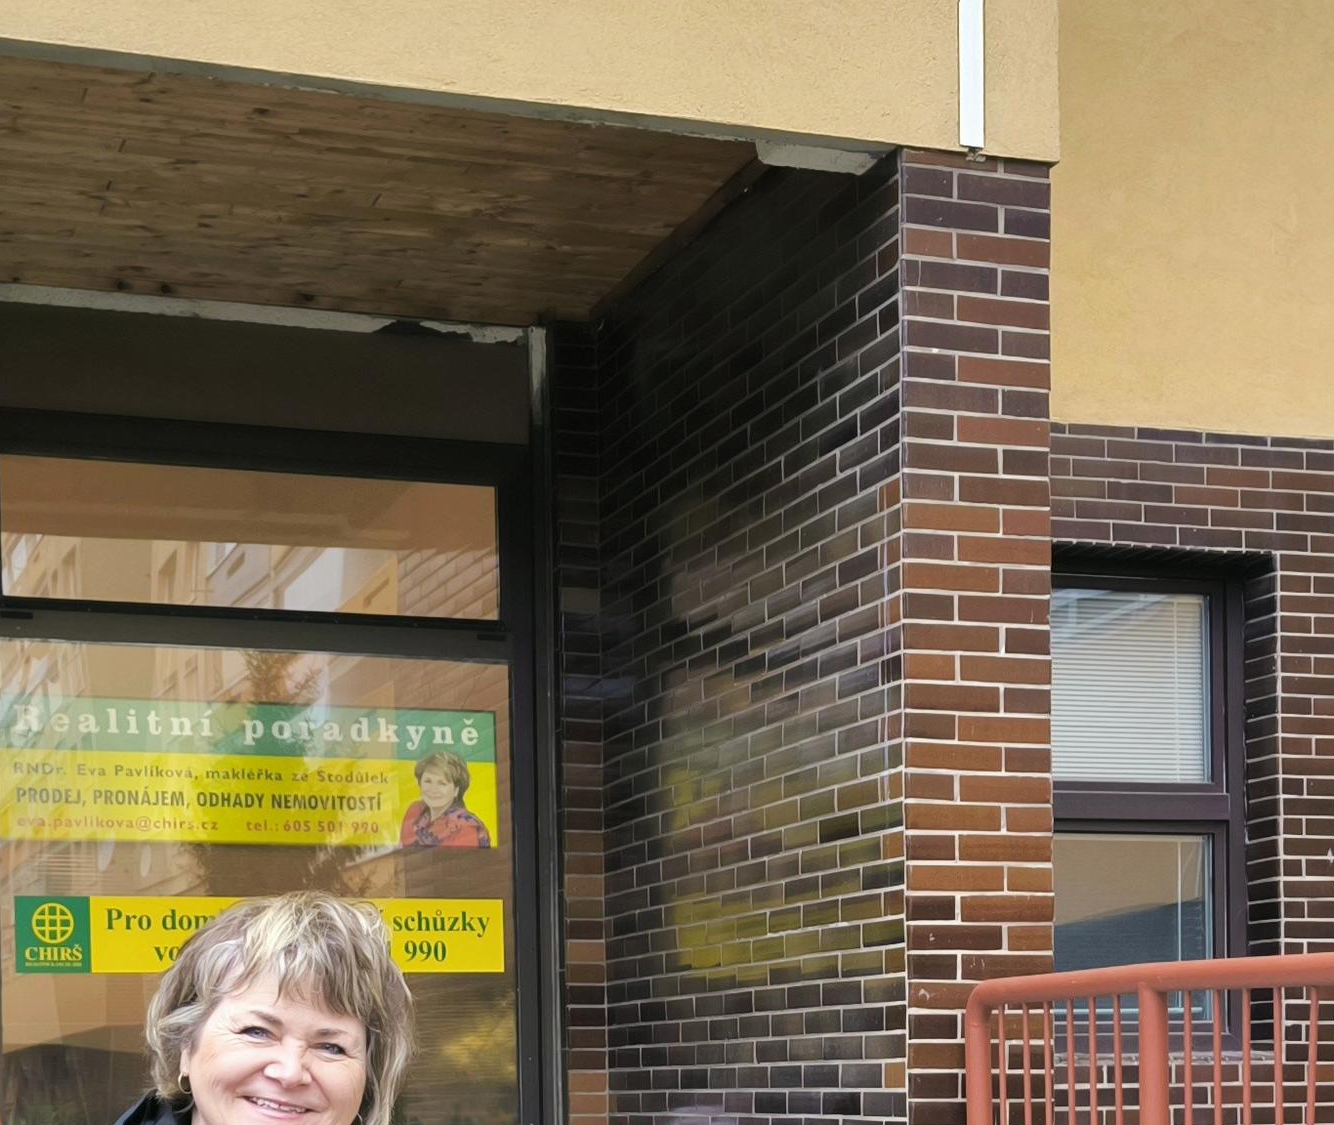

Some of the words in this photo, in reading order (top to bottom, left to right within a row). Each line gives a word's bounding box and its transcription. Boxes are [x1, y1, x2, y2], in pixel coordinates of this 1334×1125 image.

[12, 704, 214, 737] Realitní
[243, 717, 479, 750] poradkyně
[13, 761, 67, 775] RNDr.
[77, 763, 107, 776] Eva
[317, 769, 389, 785] Stodůlek
[16, 787, 86, 807] PRODEJ,
[93, 786, 190, 809] PRONÁJEM,
[196, 791, 265, 809] ODHADY
[271, 792, 382, 812] NEMOVITOSTÍ
[351, 822, 380, 834] 990
[105, 908, 152, 931] Pro
[393, 909, 490, 938] schůzky
[25, 944, 83, 961] CHIRŠ
[404, 940, 447, 962] 990
